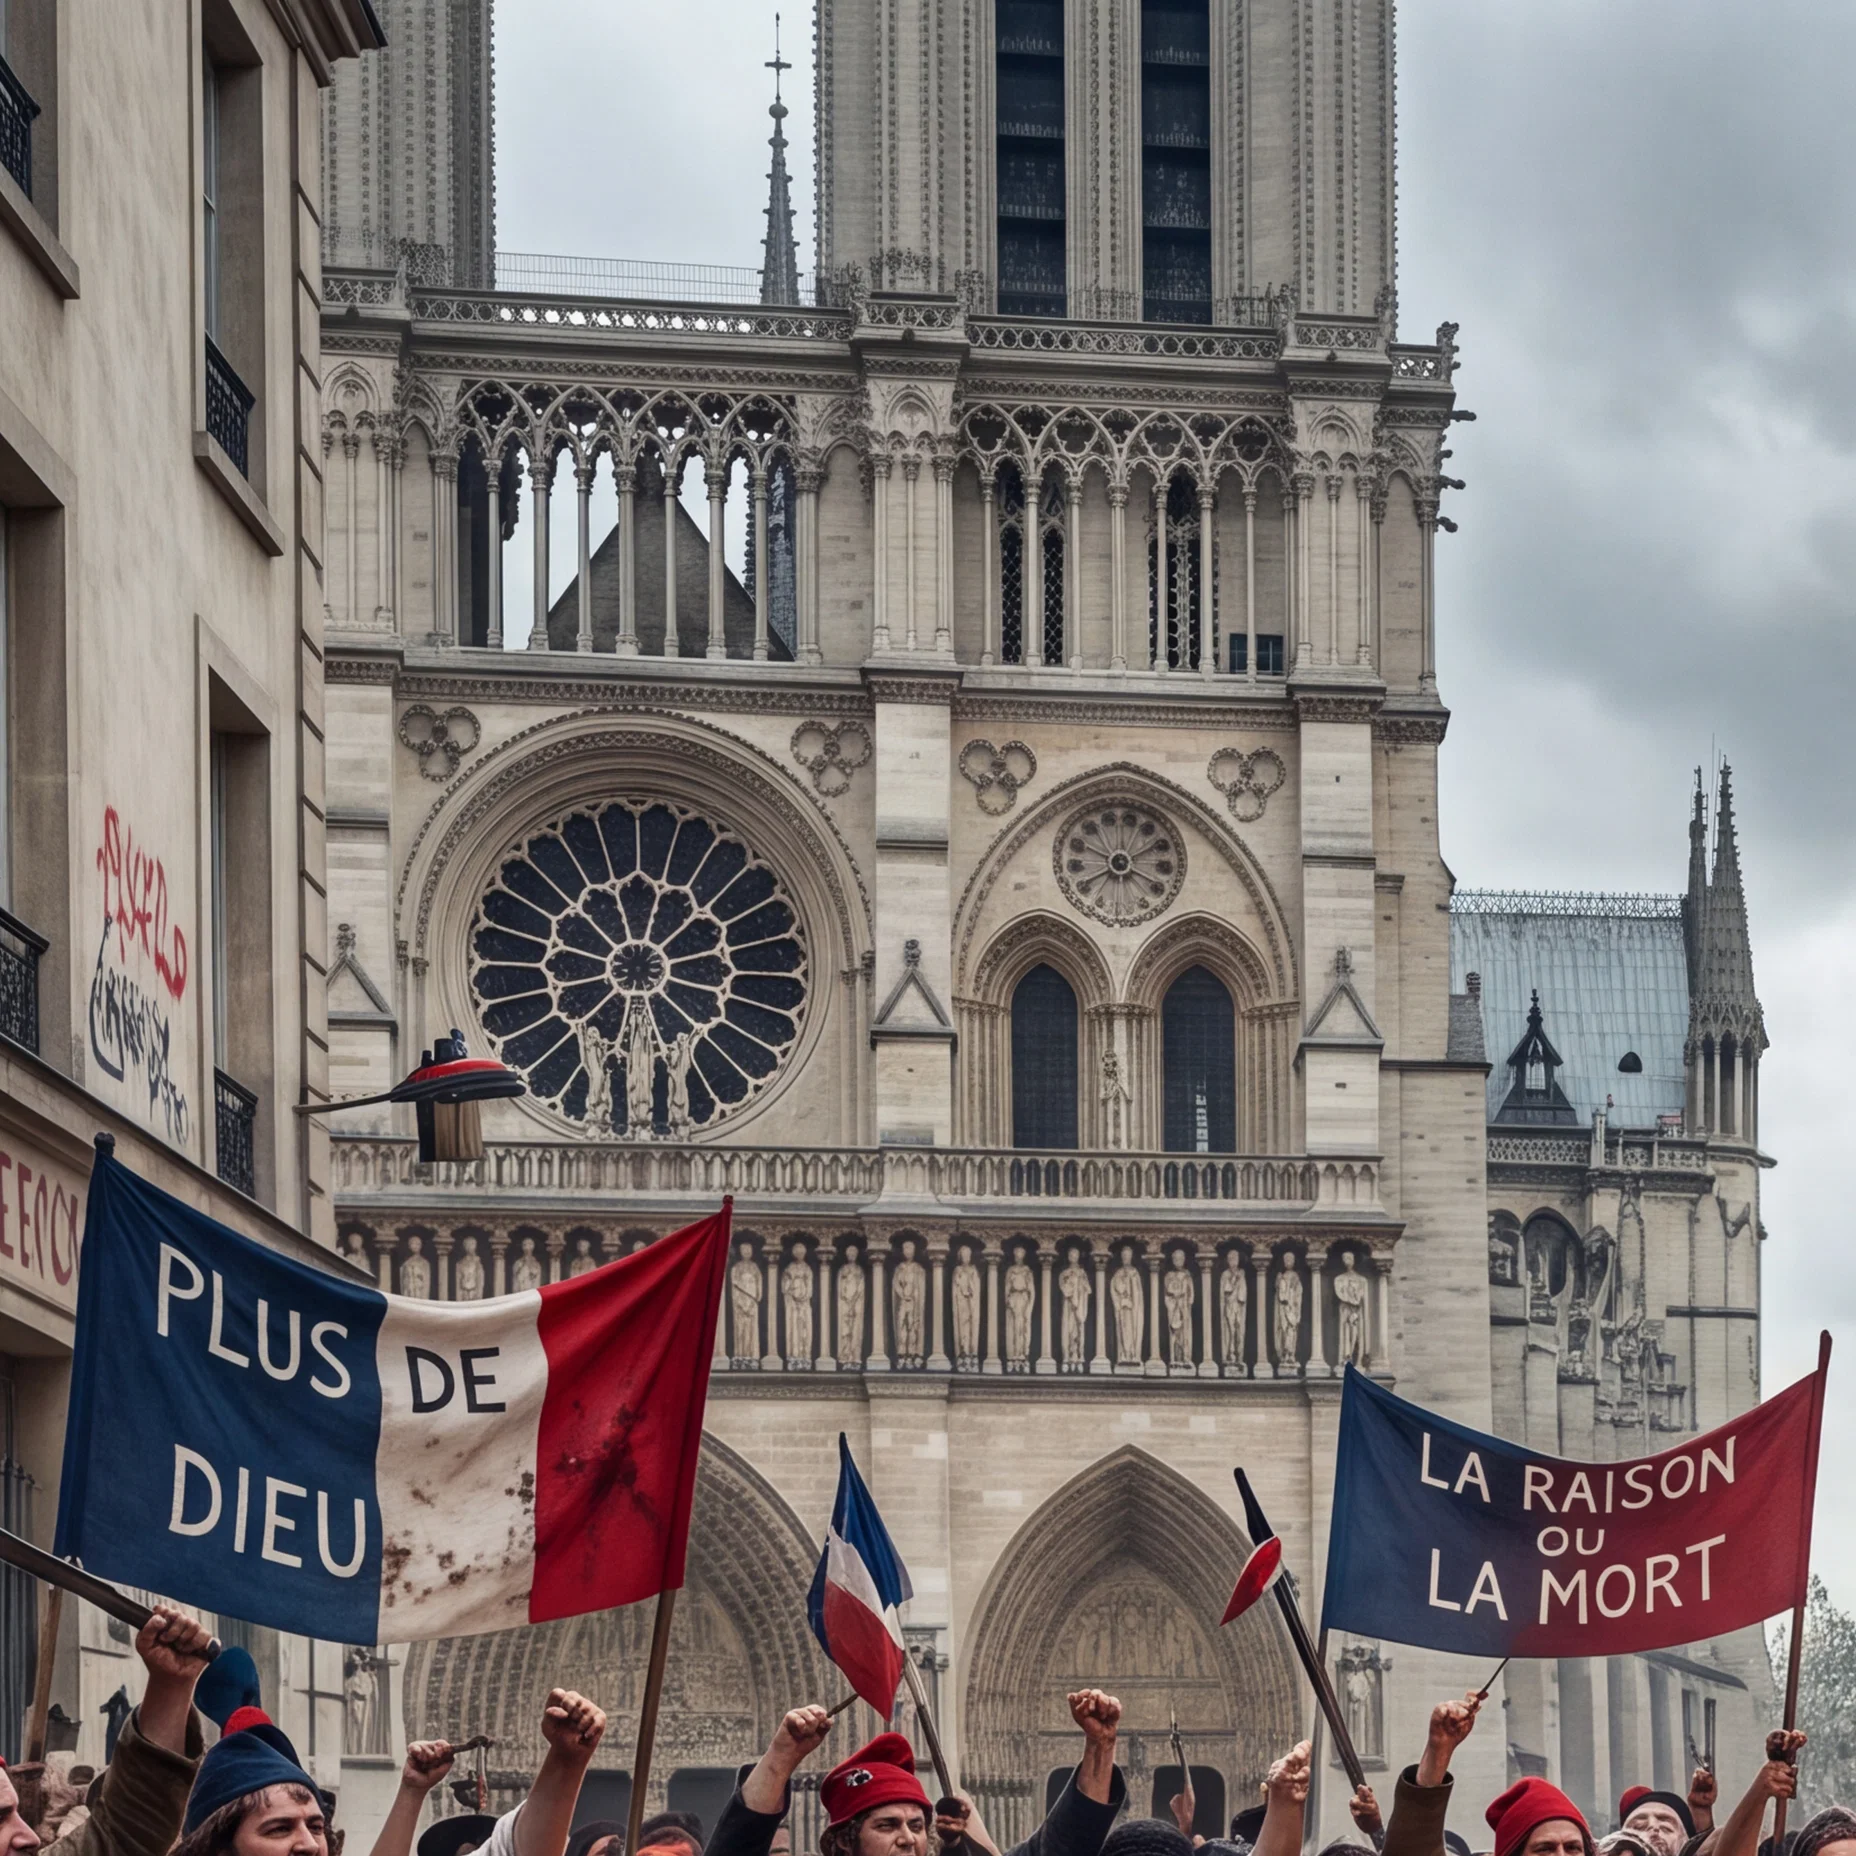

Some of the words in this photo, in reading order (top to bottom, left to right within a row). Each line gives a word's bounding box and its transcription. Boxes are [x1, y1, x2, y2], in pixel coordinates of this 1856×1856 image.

[156, 1242, 352, 1399] PLUS
[404, 1345, 507, 1414] DE
[168, 1443, 366, 1579] DIEU
[1420, 1432, 1491, 1503] LA
[1523, 1435, 1737, 1514] RAISON
[1428, 1547, 1509, 1621] LA
[1539, 1533, 1726, 1625] MORT
[1536, 1526, 1605, 1557] OU
